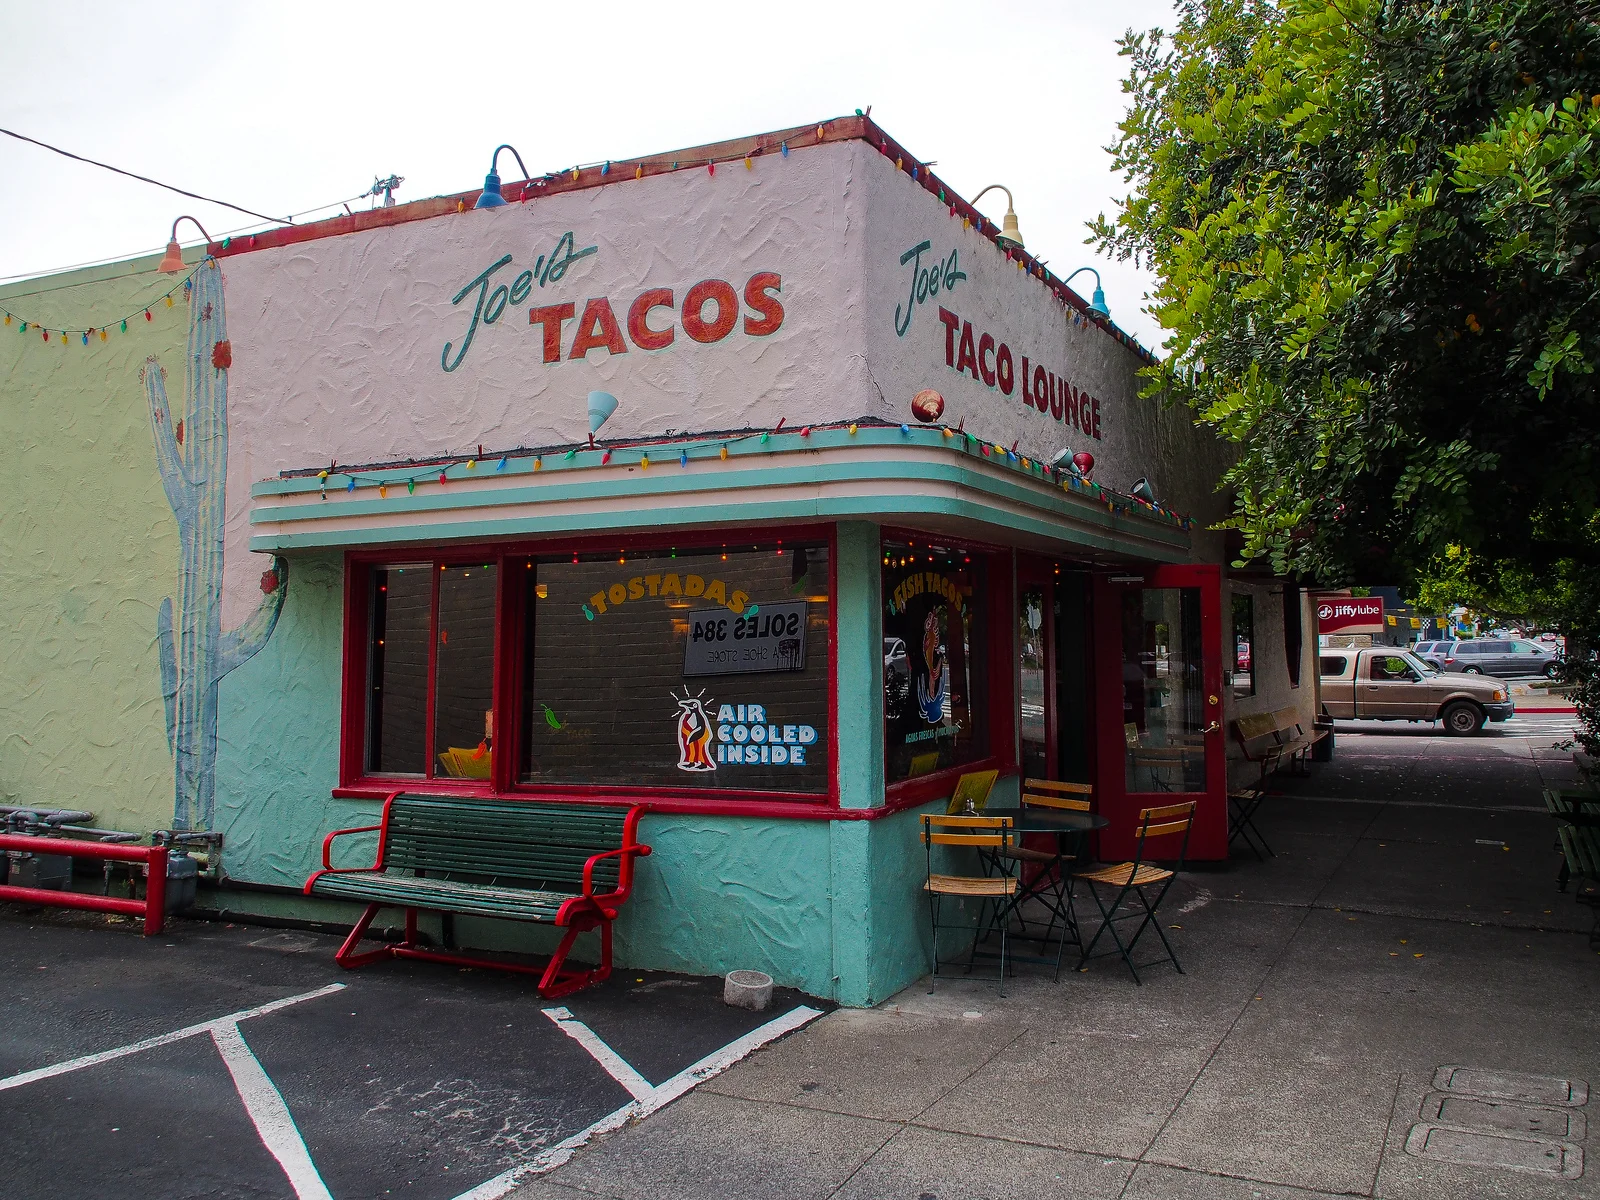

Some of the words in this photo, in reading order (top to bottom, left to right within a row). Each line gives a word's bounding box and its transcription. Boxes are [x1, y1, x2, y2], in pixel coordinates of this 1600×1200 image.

[441, 231, 598, 373] Joe's
[895, 239, 967, 337] Joe's
[528, 272, 786, 364] TACOS
[938, 305, 1014, 396] TACO
[1021, 355, 1102, 441] LOUNGE
[590, 573, 749, 614] TOSTADAS
[893, 572, 924, 610] FISH
[925, 571, 963, 612] TACOS
[716, 704, 767, 724] AIR
[716, 725, 819, 745] COOLED
[716, 745, 807, 766] INSIDE
